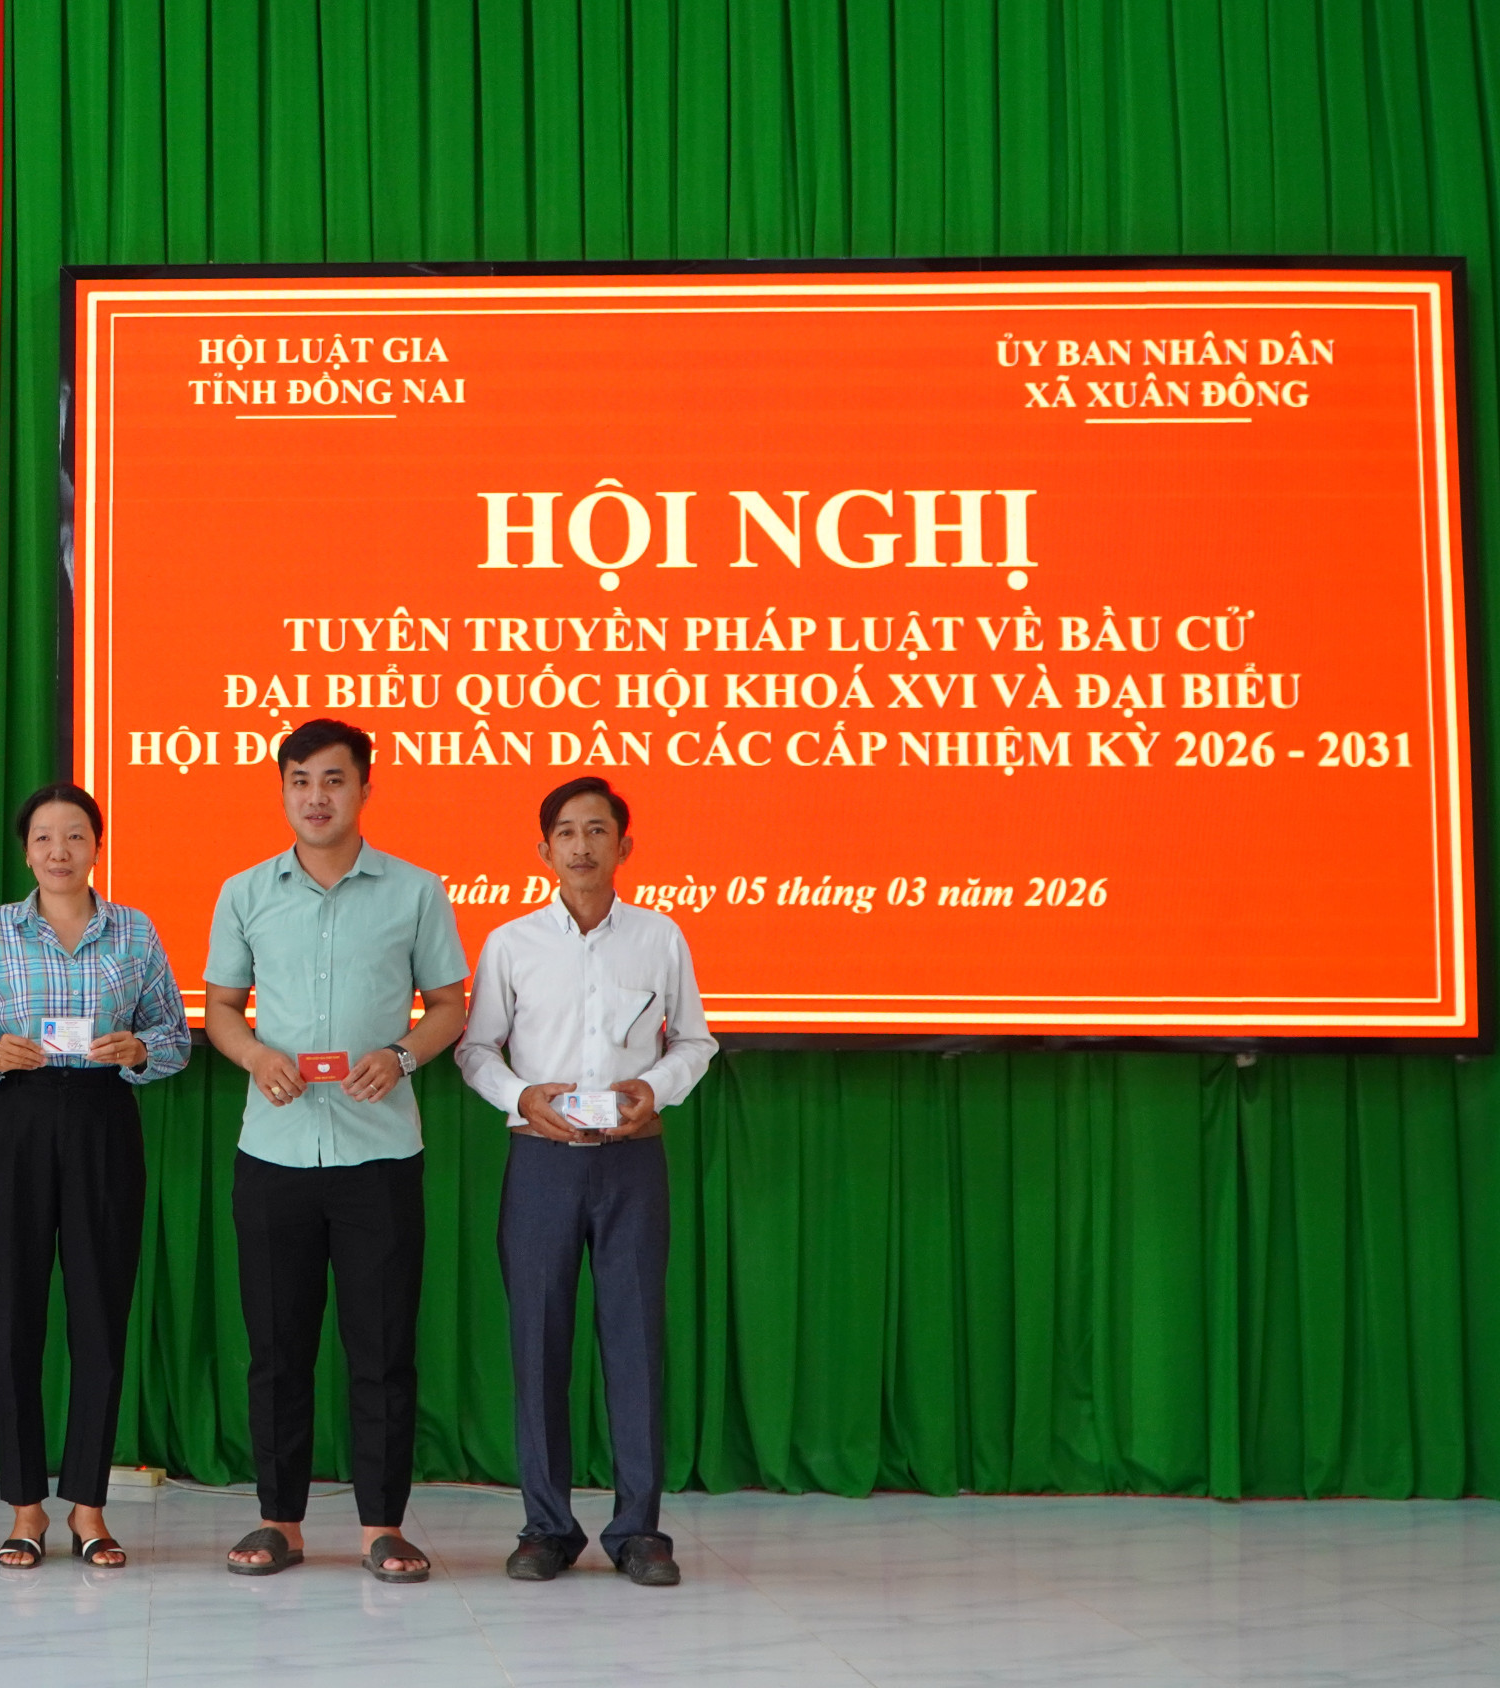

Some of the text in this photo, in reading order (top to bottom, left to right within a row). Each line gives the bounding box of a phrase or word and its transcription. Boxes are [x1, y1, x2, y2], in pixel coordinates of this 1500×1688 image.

[199, 333, 449, 370] HỘI LUẬT GIA
[996, 330, 1334, 367] ỦY BAN NHÂN DÂN
[188, 371, 466, 405] TỈNH ĐỒNG NAI
[1025, 372, 1309, 408] XÃ XUÂN ĐÔNG
[477, 477, 1038, 592] HỘI NGHỊ
[284, 605, 1256, 661] TUYÊN TRUYỀN PHÁP LUẬT VỀ BẦU CỬ
[223, 662, 1301, 718] ĐẠI BIỂU QUỐC HỘI KHOÁ XVI VÀ ĐẠI BIỂU
[128, 725, 220, 775] HỘI
[392, 719, 534, 766] NHÂN
[548, 719, 653, 766] DÂN
[667, 720, 772, 767] CÁC
[786, 720, 888, 767] CẤP
[898, 725, 1072, 777] NHIỆM
[1088, 721, 1161, 767] KỲ
[1175, 731, 1276, 767] 2026
[1287, 750, 1305, 759] -
[1317, 732, 1412, 768] 2031
[439, 874, 511, 905] uân
[634, 875, 717, 913] ngày
[727, 876, 767, 905] 05
[777, 875, 876, 914] tháng
[887, 877, 928, 907] 03
[937, 877, 1014, 907] năm
[1024, 877, 1108, 907] 2026
